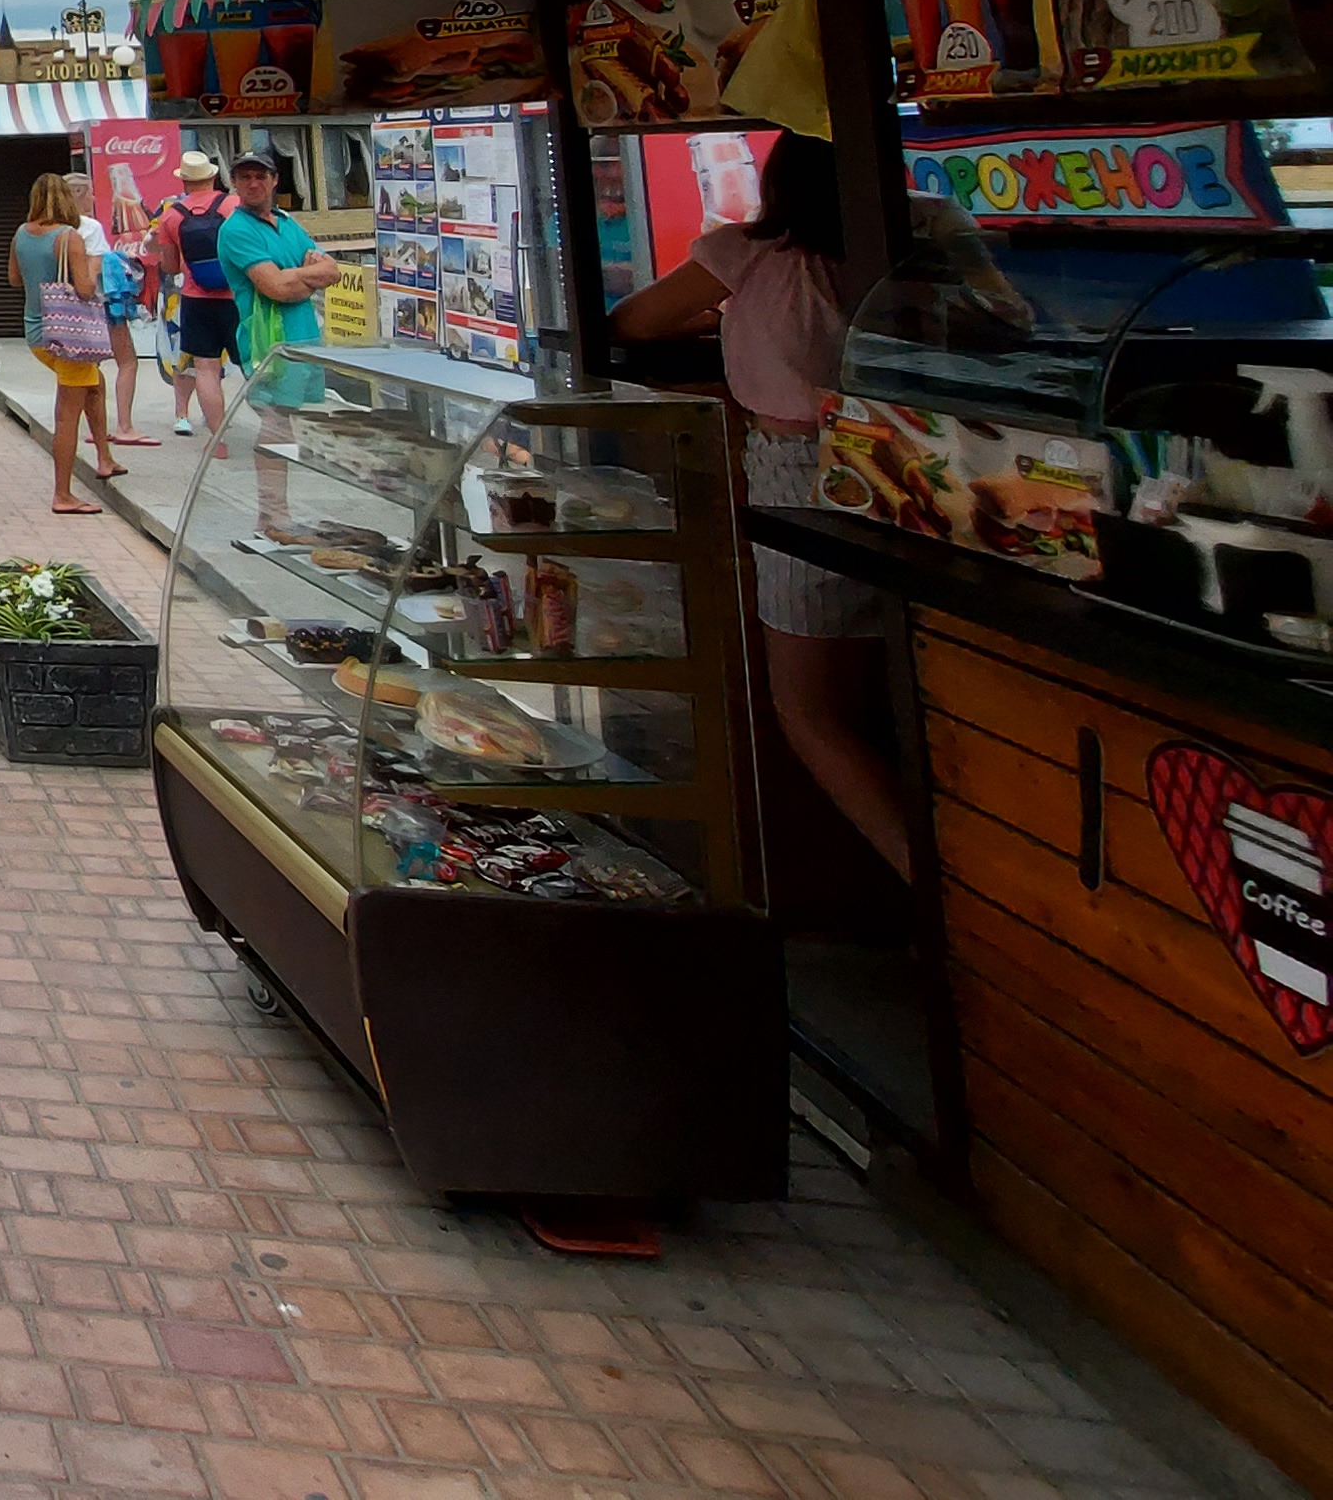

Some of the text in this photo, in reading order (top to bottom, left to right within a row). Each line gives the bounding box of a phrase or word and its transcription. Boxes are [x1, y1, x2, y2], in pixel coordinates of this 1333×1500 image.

[456, 1, 498, 18] 200
[1147, 0, 1199, 36] 200
[46, 62, 129, 81] КОРОН
[245, 79, 288, 93] 230
[233, 98, 287, 111] СМУЗИ
[904, 144, 1232, 211] ОРОЖЕНОЕ
[1243, 880, 1326, 936] Coffee
